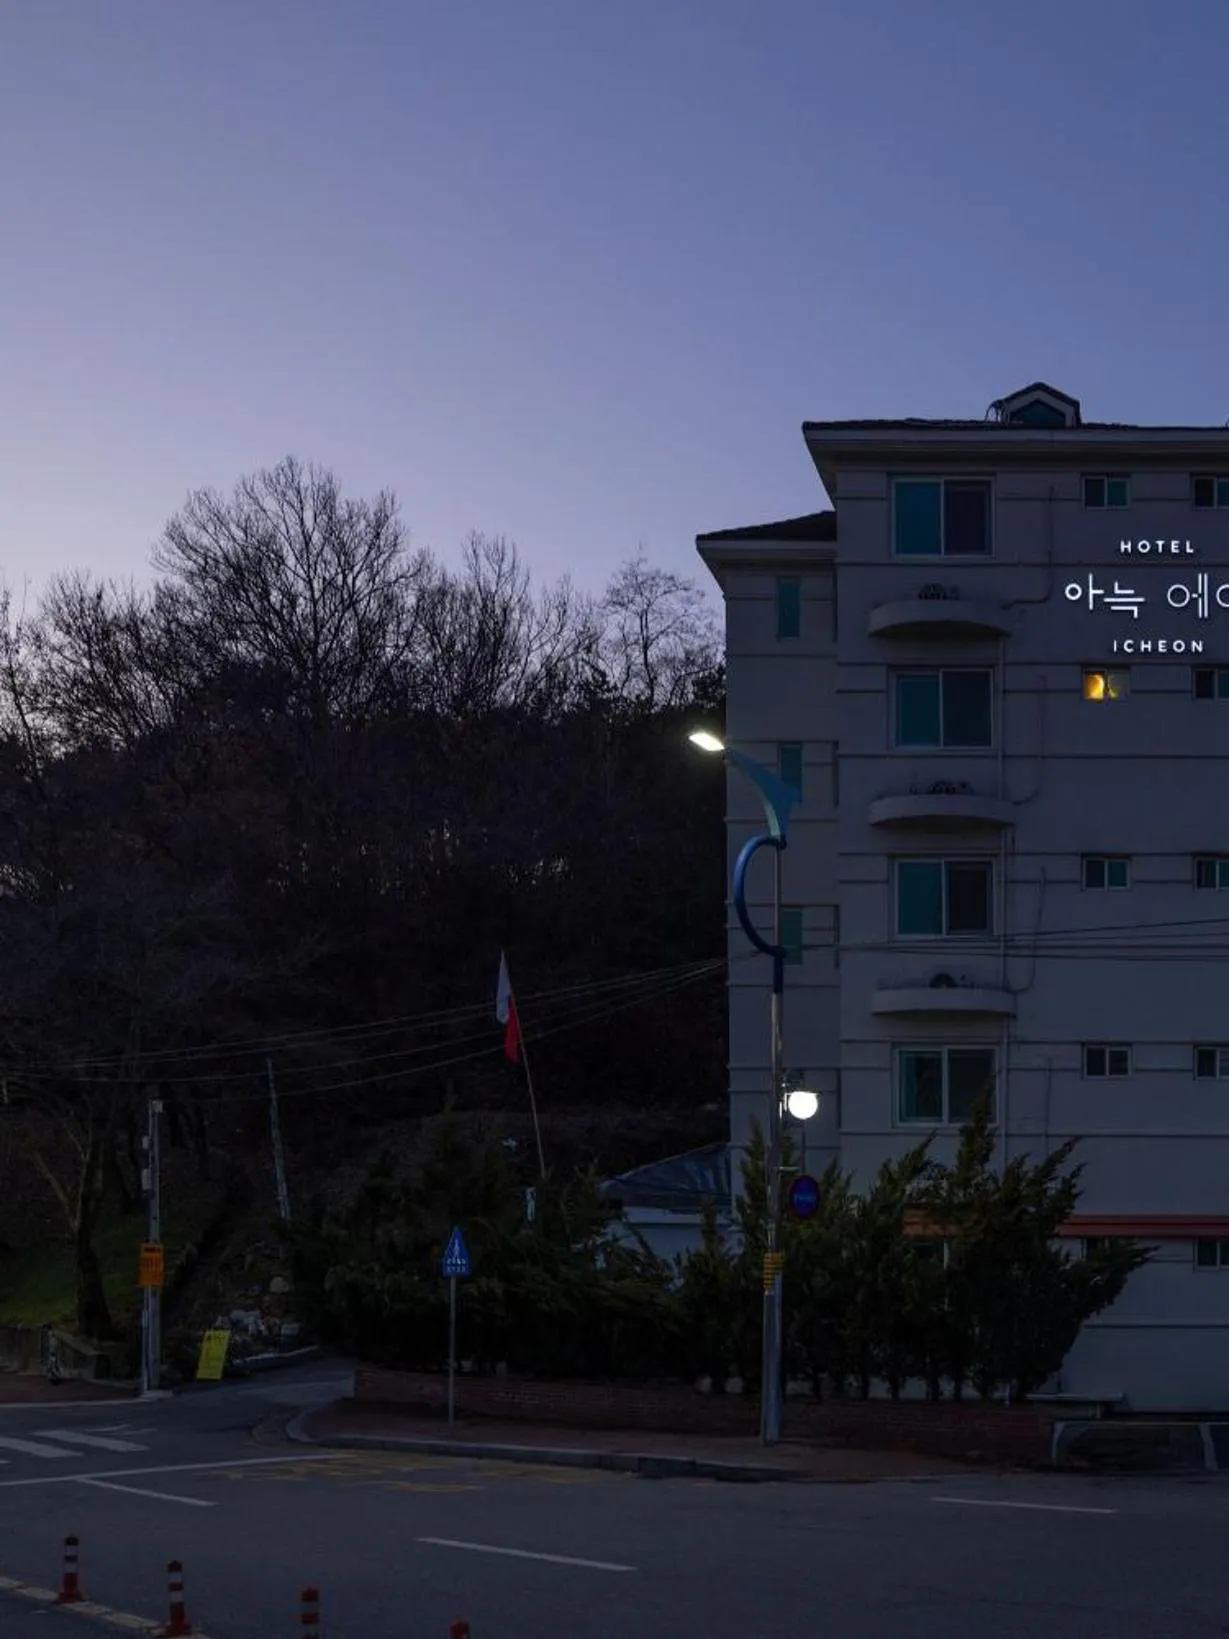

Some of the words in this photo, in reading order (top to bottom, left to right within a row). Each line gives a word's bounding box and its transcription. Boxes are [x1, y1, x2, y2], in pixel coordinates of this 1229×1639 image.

[1120, 539, 1194, 553] HOTEL
[1064, 572, 1146, 619] 아늑
[1113, 639, 1204, 653] ICHEON
